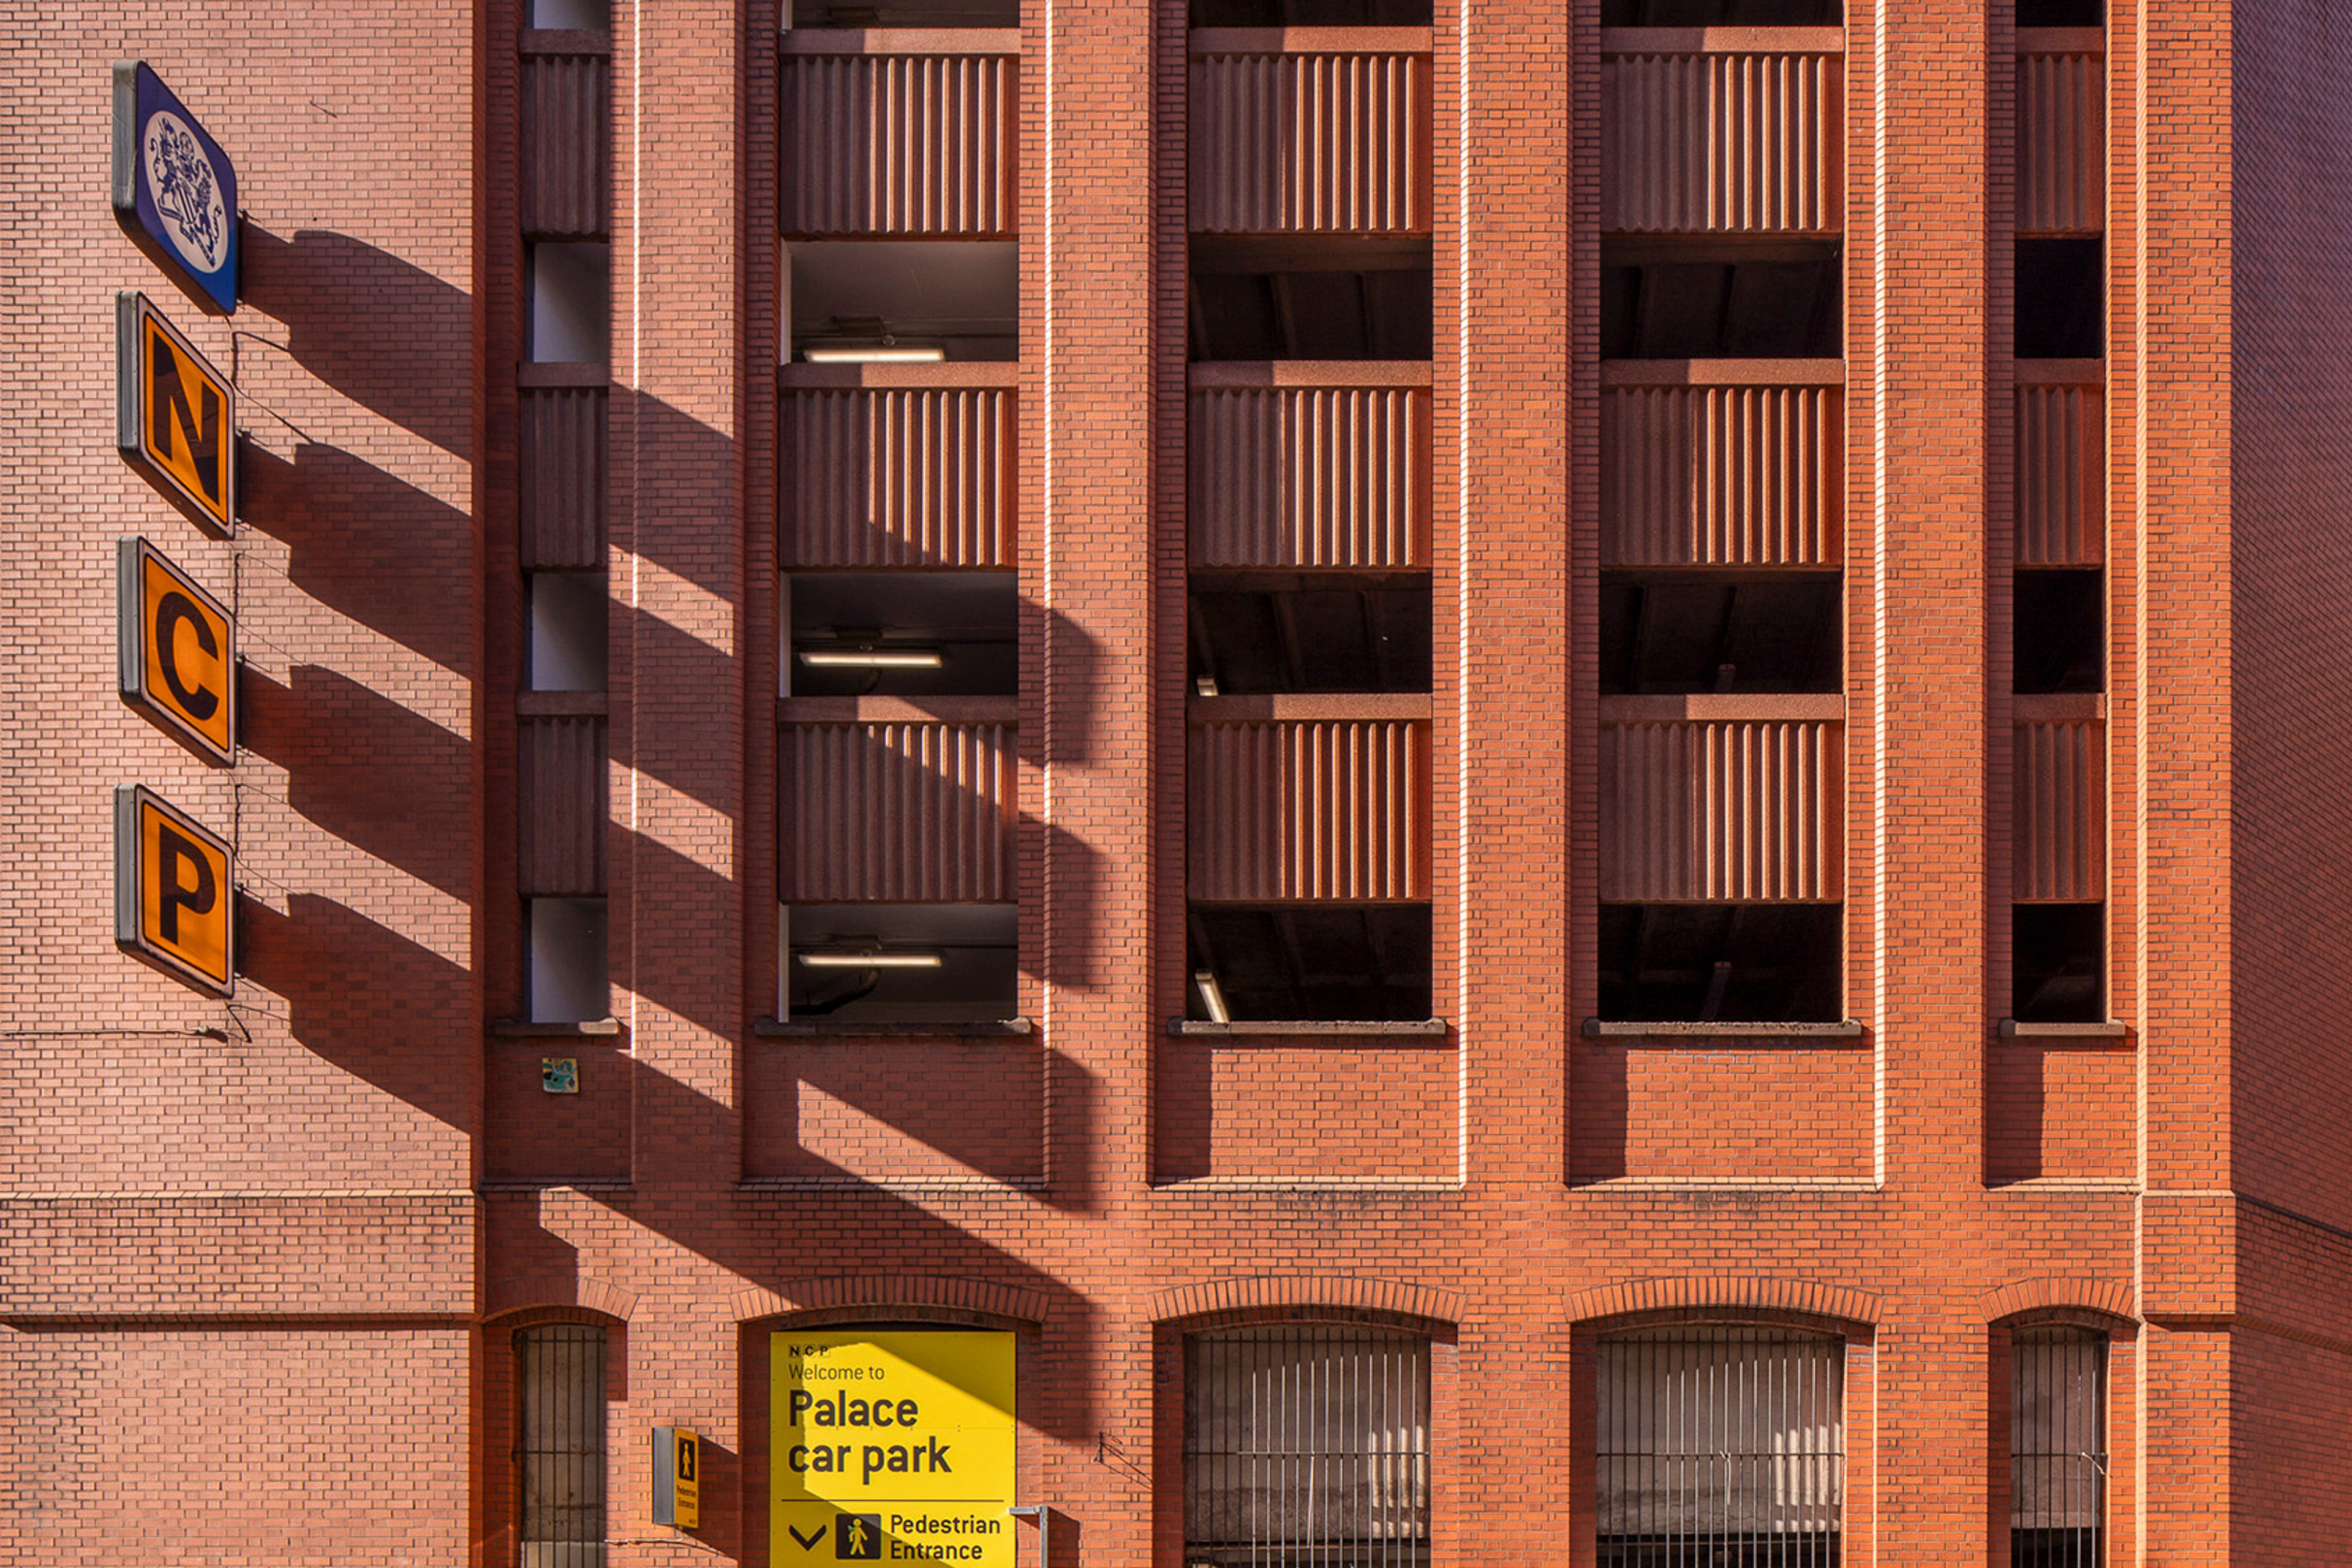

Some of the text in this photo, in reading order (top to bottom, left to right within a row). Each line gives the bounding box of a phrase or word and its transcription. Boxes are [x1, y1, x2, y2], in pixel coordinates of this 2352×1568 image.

[153, 330, 221, 507] N
[156, 591, 219, 722] C
[159, 821, 216, 946] P
[788, 1363, 885, 1381] Welcome to
[789, 1389, 919, 1427] Palace
[788, 1435, 953, 1485] car park
[891, 1514, 1001, 1534] Pedestrian
[891, 1540, 983, 1560] Entrance
